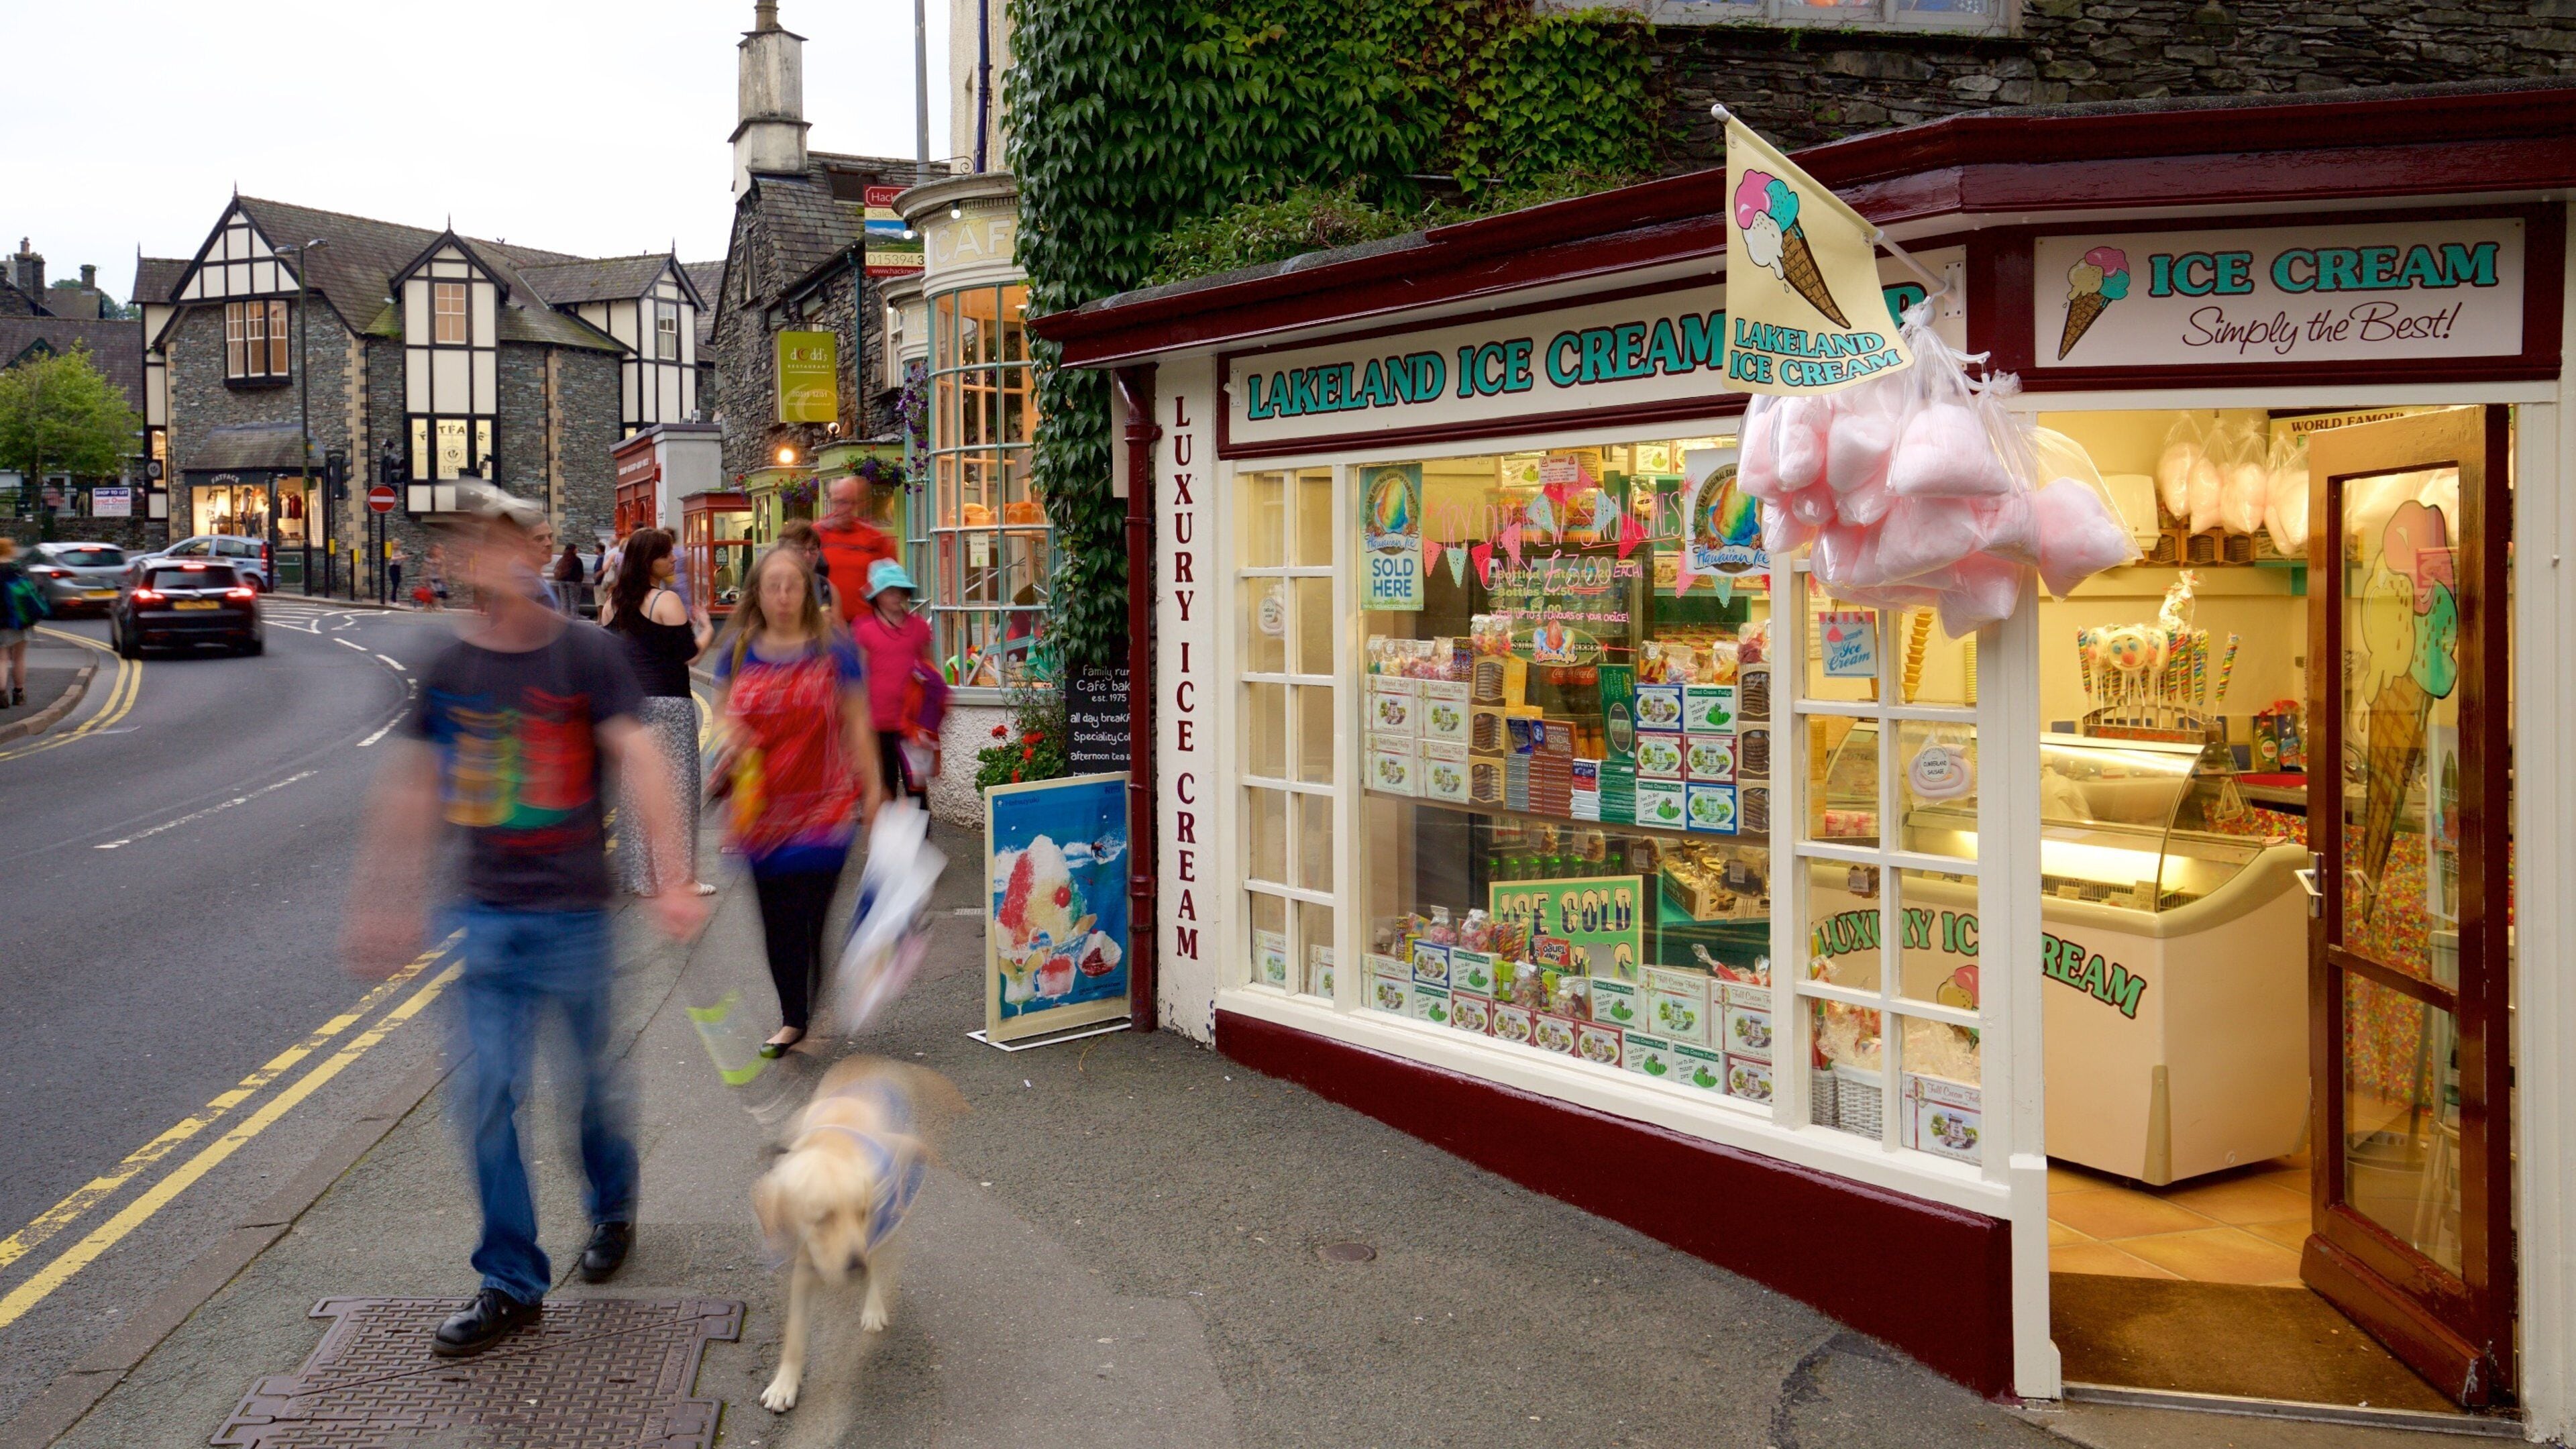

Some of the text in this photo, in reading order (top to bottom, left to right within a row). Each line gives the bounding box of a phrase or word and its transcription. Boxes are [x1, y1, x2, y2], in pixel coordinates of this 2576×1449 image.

[871, 209, 895, 218] Sales
[867, 254, 914, 265] 015394
[2149, 241, 2500, 297] ICE CREAM
[2182, 301, 2463, 354] Simply the Best!
[1735, 318, 1886, 358] LAKELAND
[790, 347, 828, 362] dodd's
[1247, 309, 1726, 421] LAKELAND ICE CREAM
[1729, 349, 1902, 386] ICE CREAM
[2291, 417, 2343, 432] WORLD
[211, 474, 240, 484] FATFACE
[1699, 494, 1707, 507] THE
[1705, 471, 1725, 496] ORIGINAL
[1174, 395, 1194, 621] LUXURY
[1697, 542, 1770, 568] Hawaiian Ice
[1372, 557, 1414, 578] SOLD
[1613, 564, 1644, 579] EACH!
[1373, 578, 1412, 598] HERE
[1497, 587, 1540, 596] Bottles
[1543, 611, 1575, 621] FLAVOURS
[1576, 612, 1585, 621] OF
[1586, 612, 1603, 622] YOUR
[1603, 611, 1630, 623] CHOICE!
[1513, 639, 1599, 653] SOLD HERE
[1839, 640, 1862, 658] Ice
[1827, 651, 1871, 672] Cream
[1082, 664, 1113, 680] family
[1076, 679, 1107, 692] Café
[1091, 694, 1127, 702] est. 1975
[1176, 642, 1195, 753] ICE
[1070, 712, 1081, 723] all
[1082, 712, 1099, 728] day
[1073, 731, 1117, 746] Speciality
[1546, 734, 1570, 745] KENDAL
[1070, 751, 1110, 761] afternoon
[1112, 752, 1125, 761] tea
[1559, 745, 1572, 753] CAKE
[2262, 745, 2277, 753] FAIRY
[1176, 772, 1199, 961] CREAM
[1500, 892, 1550, 935] ICE
[1560, 888, 1632, 934] COLD
[1542, 943, 1566, 955] Tango
[1941, 910, 1979, 958] IC
[2041, 931, 2147, 1020] REAM
[1927, 1083, 1964, 1099] Full Cream
